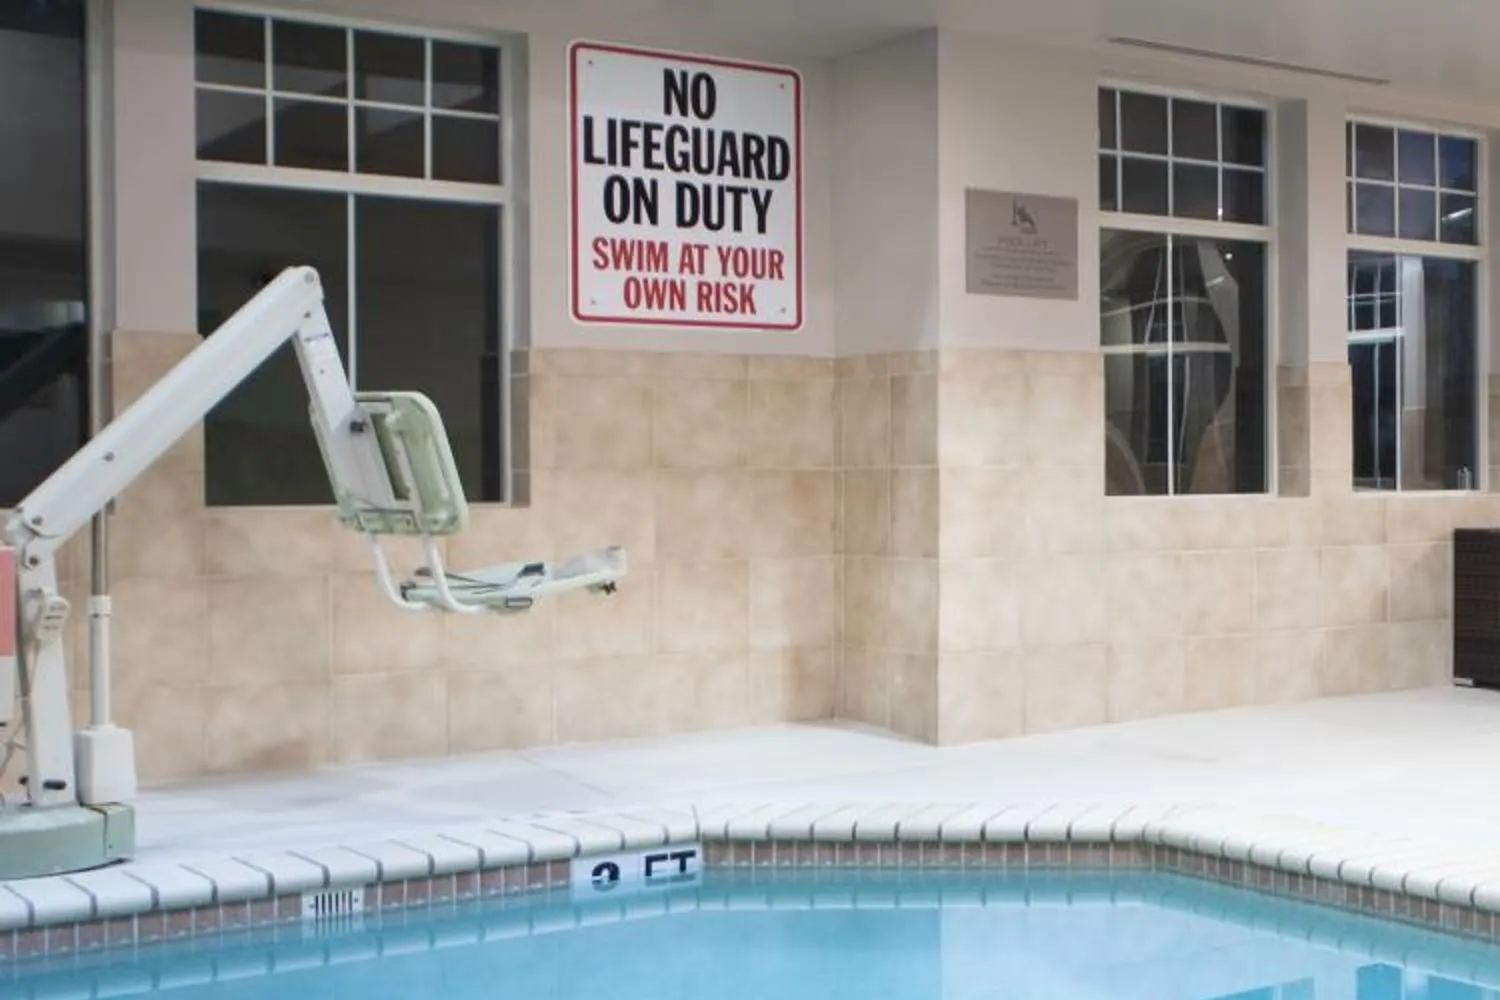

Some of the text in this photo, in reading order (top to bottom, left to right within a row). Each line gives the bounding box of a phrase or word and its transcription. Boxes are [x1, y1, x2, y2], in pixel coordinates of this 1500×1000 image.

[663, 67, 717, 121] NO
[583, 115, 791, 182] LIFEGUARD
[603, 174, 773, 235] ON DUTY
[592, 236, 785, 281] SWIM AT YOUR
[623, 276, 757, 316] OWN RISK
